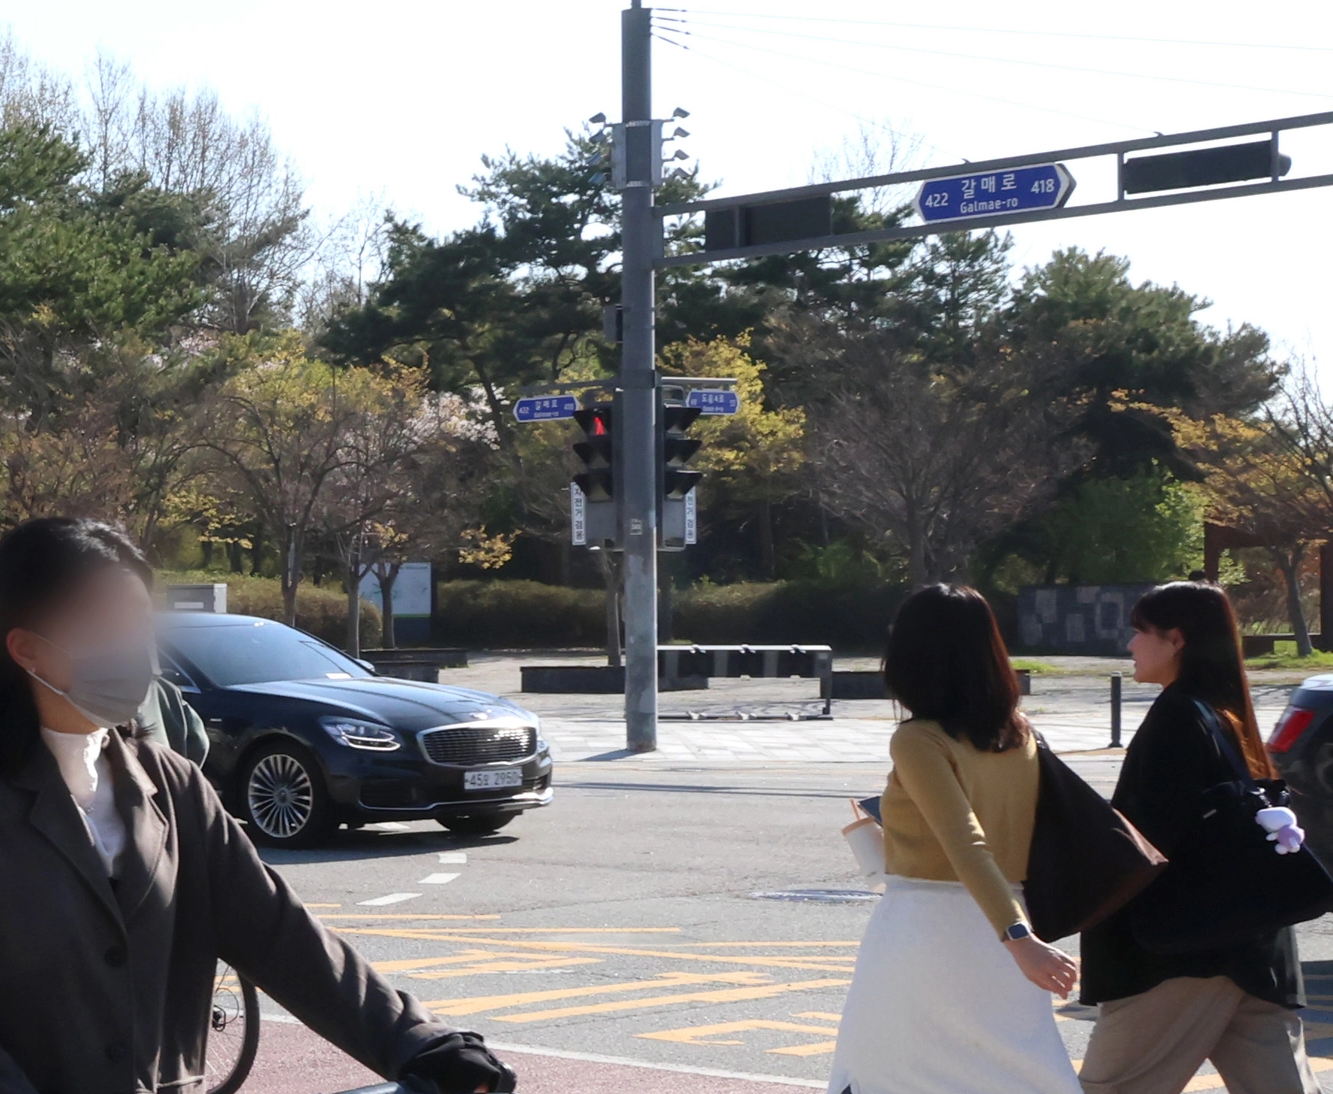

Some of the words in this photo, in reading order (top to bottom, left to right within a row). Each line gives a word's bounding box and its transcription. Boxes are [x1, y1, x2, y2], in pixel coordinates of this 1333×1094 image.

[961, 173, 1017, 199] 갈매로
[1031, 178, 1055, 194] 418
[925, 192, 949, 207] 422
[960, 198, 1019, 214] Galmae-ro
